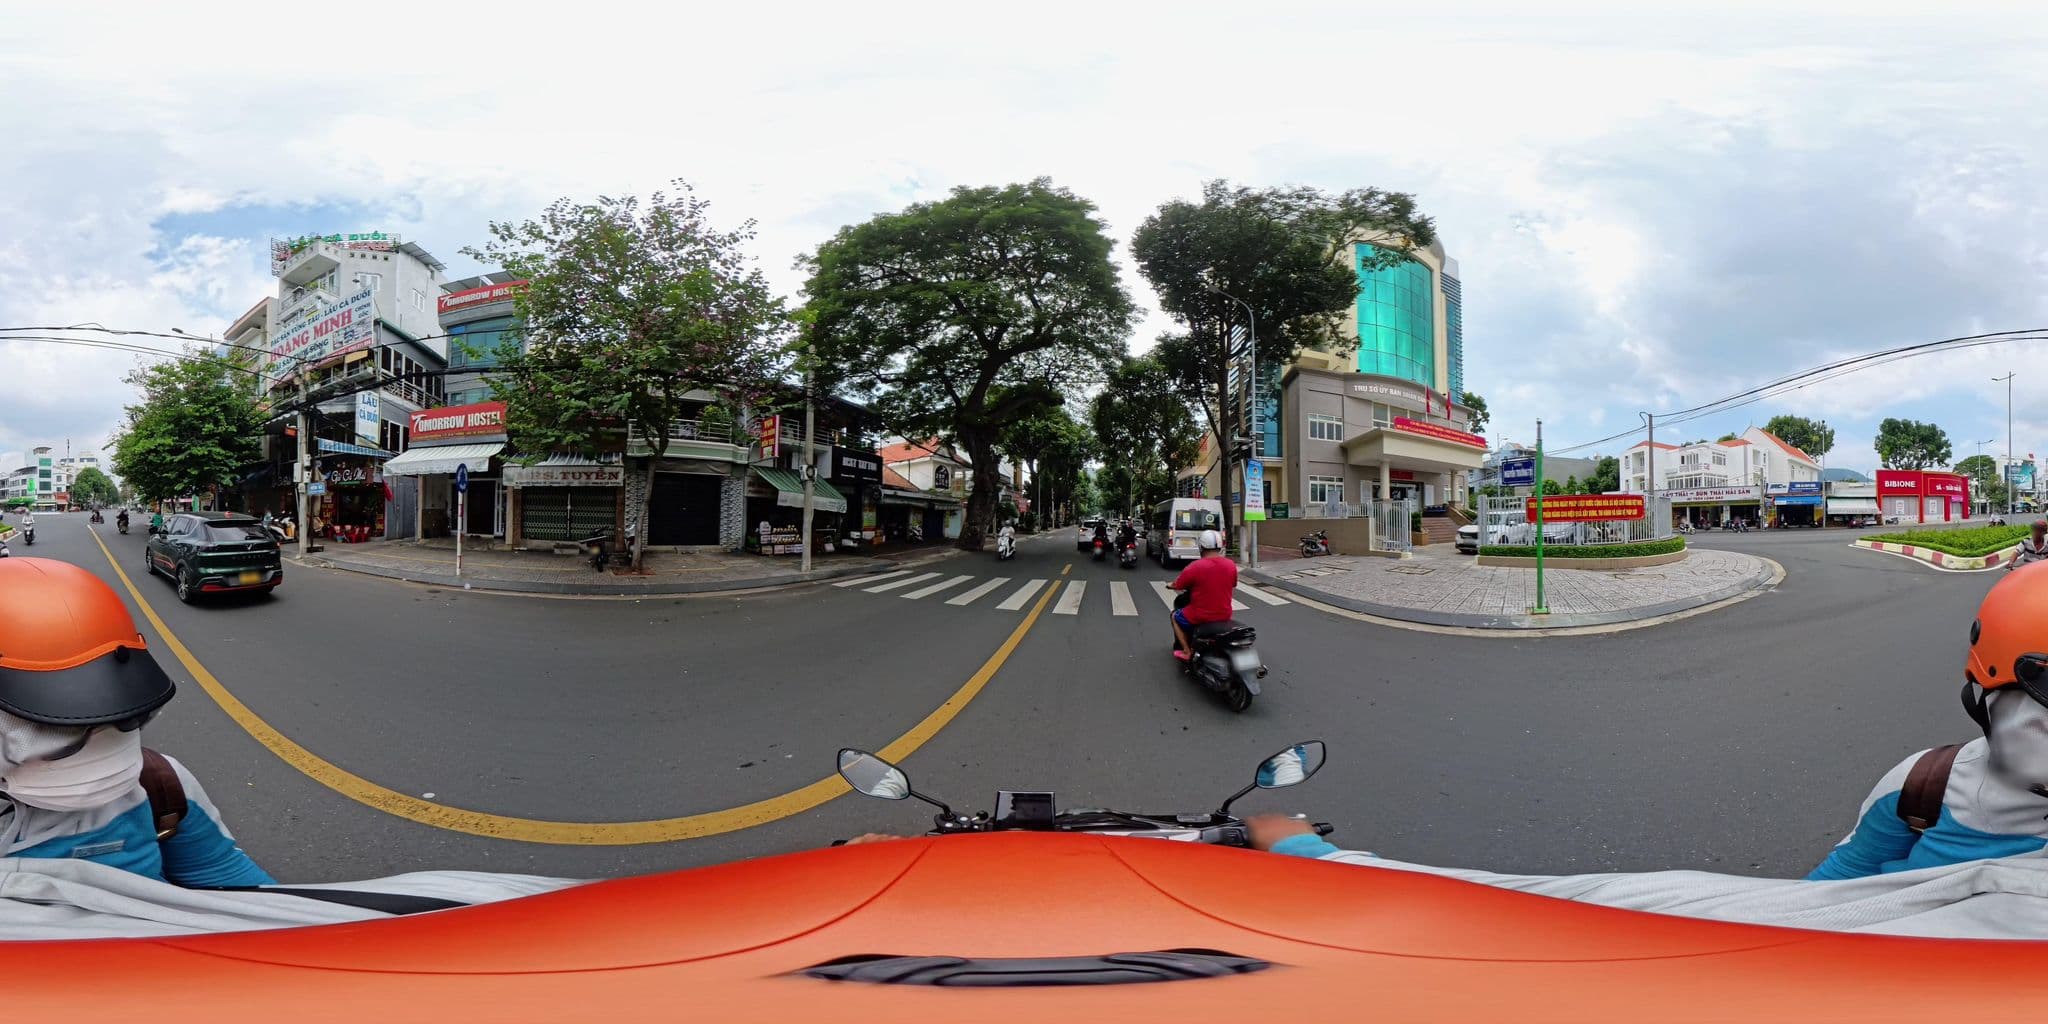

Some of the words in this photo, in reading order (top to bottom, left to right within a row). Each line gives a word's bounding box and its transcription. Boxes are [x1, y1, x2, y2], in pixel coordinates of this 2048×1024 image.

[440, 290, 490, 308] TOMORROW
[313, 308, 352, 340] MINH
[362, 391, 378, 408] LẨU
[1389, 388, 1402, 396] BAN
[359, 408, 366, 420] CÁ
[411, 414, 466, 433] TOMORROW
[467, 411, 503, 427] HOSTEL
[1884, 480, 1916, 488] BIBIONE
